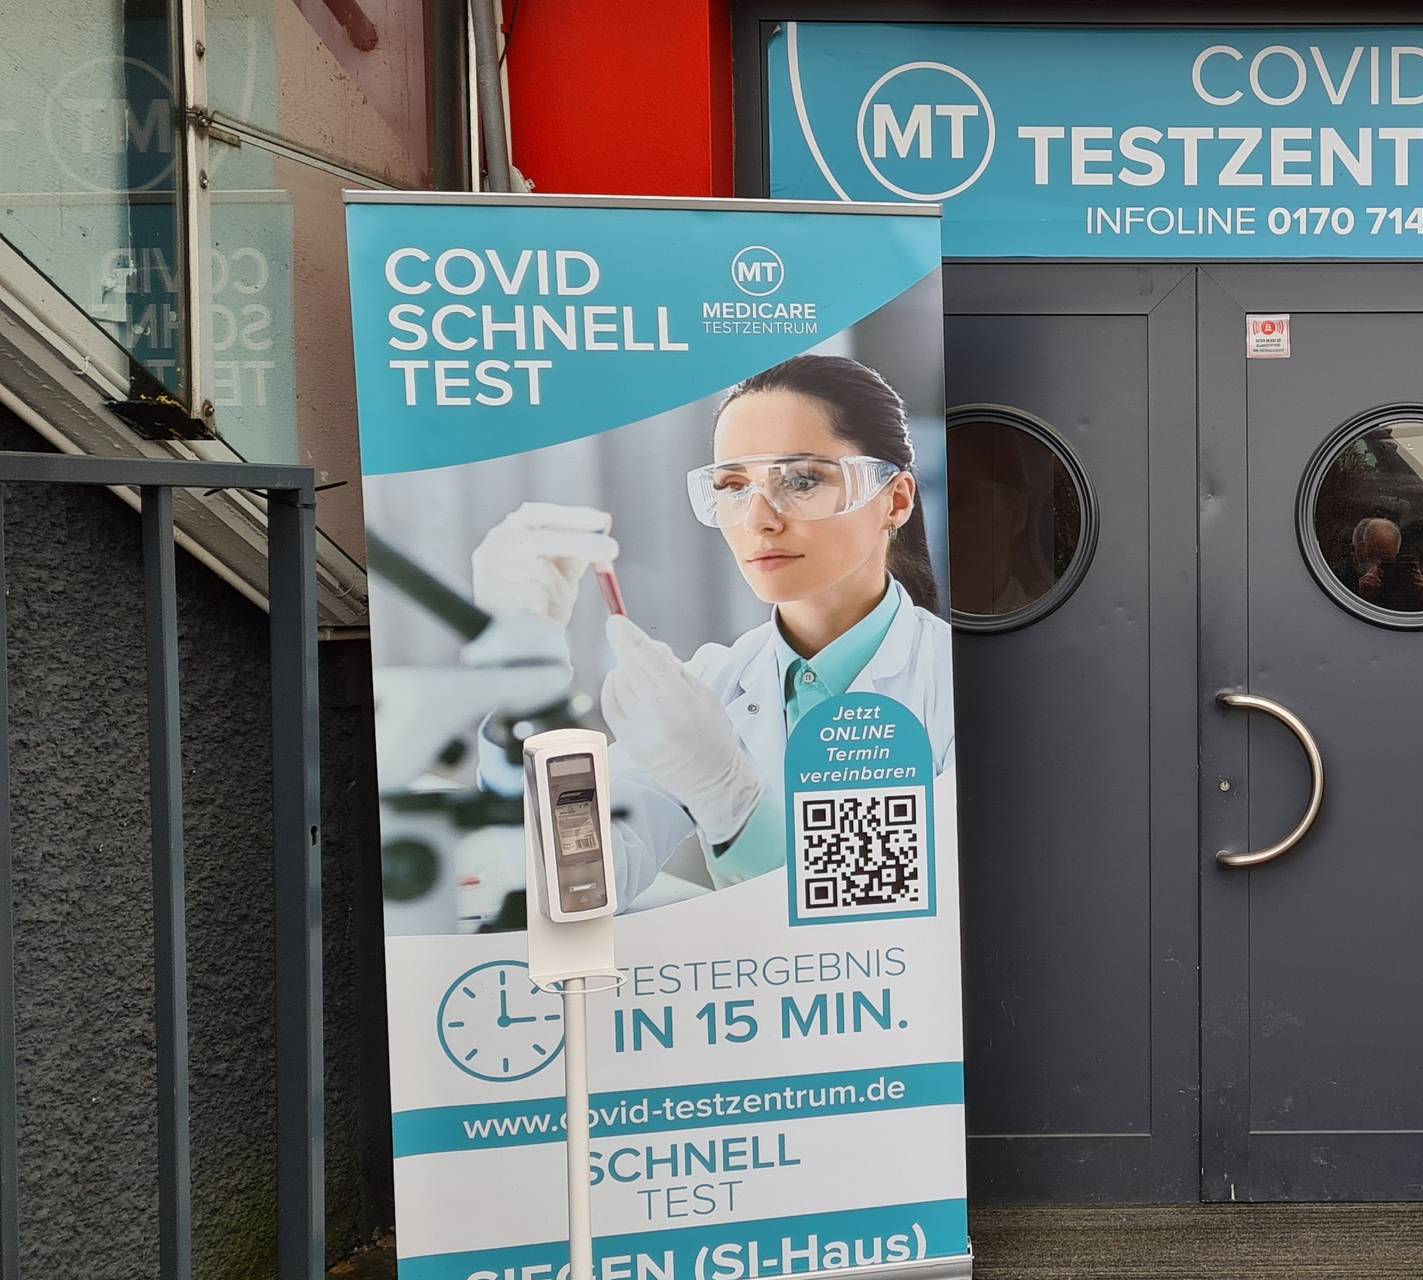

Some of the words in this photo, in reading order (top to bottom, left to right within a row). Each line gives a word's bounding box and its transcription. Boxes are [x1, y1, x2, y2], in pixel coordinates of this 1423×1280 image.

[873, 104, 979, 160] MT
[1086, 207, 1256, 236] INFOLINE
[1268, 207, 1356, 236] 0170
[384, 247, 600, 296] COVID
[738, 261, 777, 282] MT
[387, 303, 689, 351] SCHNELL
[702, 302, 817, 320] MEDICARE
[702, 320, 818, 335] TESTZENTRUM
[389, 359, 553, 406] TEST
[833, 705, 880, 721] Jetzt
[819, 724, 896, 742] ONLINE
[826, 746, 890, 763] Termin
[800, 766, 916, 784] vereinbaren
[616, 946, 907, 998] TESTERGEBNIS
[614, 1006, 674, 1053] IN
[696, 999, 758, 1045] 15
[781, 988, 909, 1040] MIN.
[637, 1180, 743, 1222] TEST
[694, 1222, 927, 1280] (SI-Haus)
